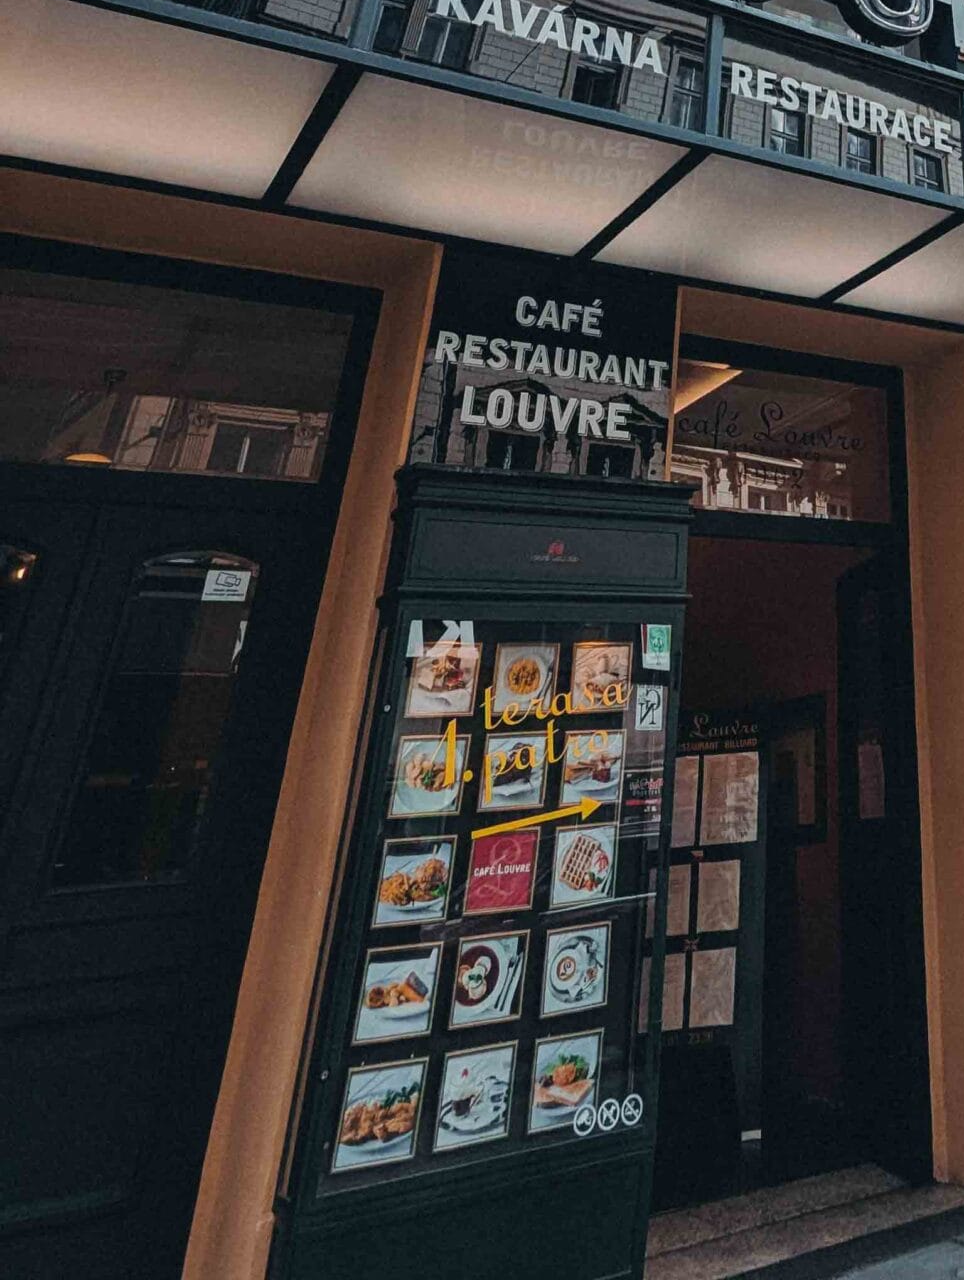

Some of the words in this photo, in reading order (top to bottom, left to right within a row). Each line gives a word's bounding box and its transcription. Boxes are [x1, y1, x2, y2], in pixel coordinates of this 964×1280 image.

[729, 60, 955, 154] RESTAURACE
[515, 296, 605, 338] CAFÉ
[434, 329, 670, 392] RESTAURANT
[459, 384, 633, 441] LOUVRE
[480, 679, 634, 730] terasa
[689, 712, 760, 738] Louvre
[432, 718, 473, 787] 1.
[483, 718, 610, 805] patro
